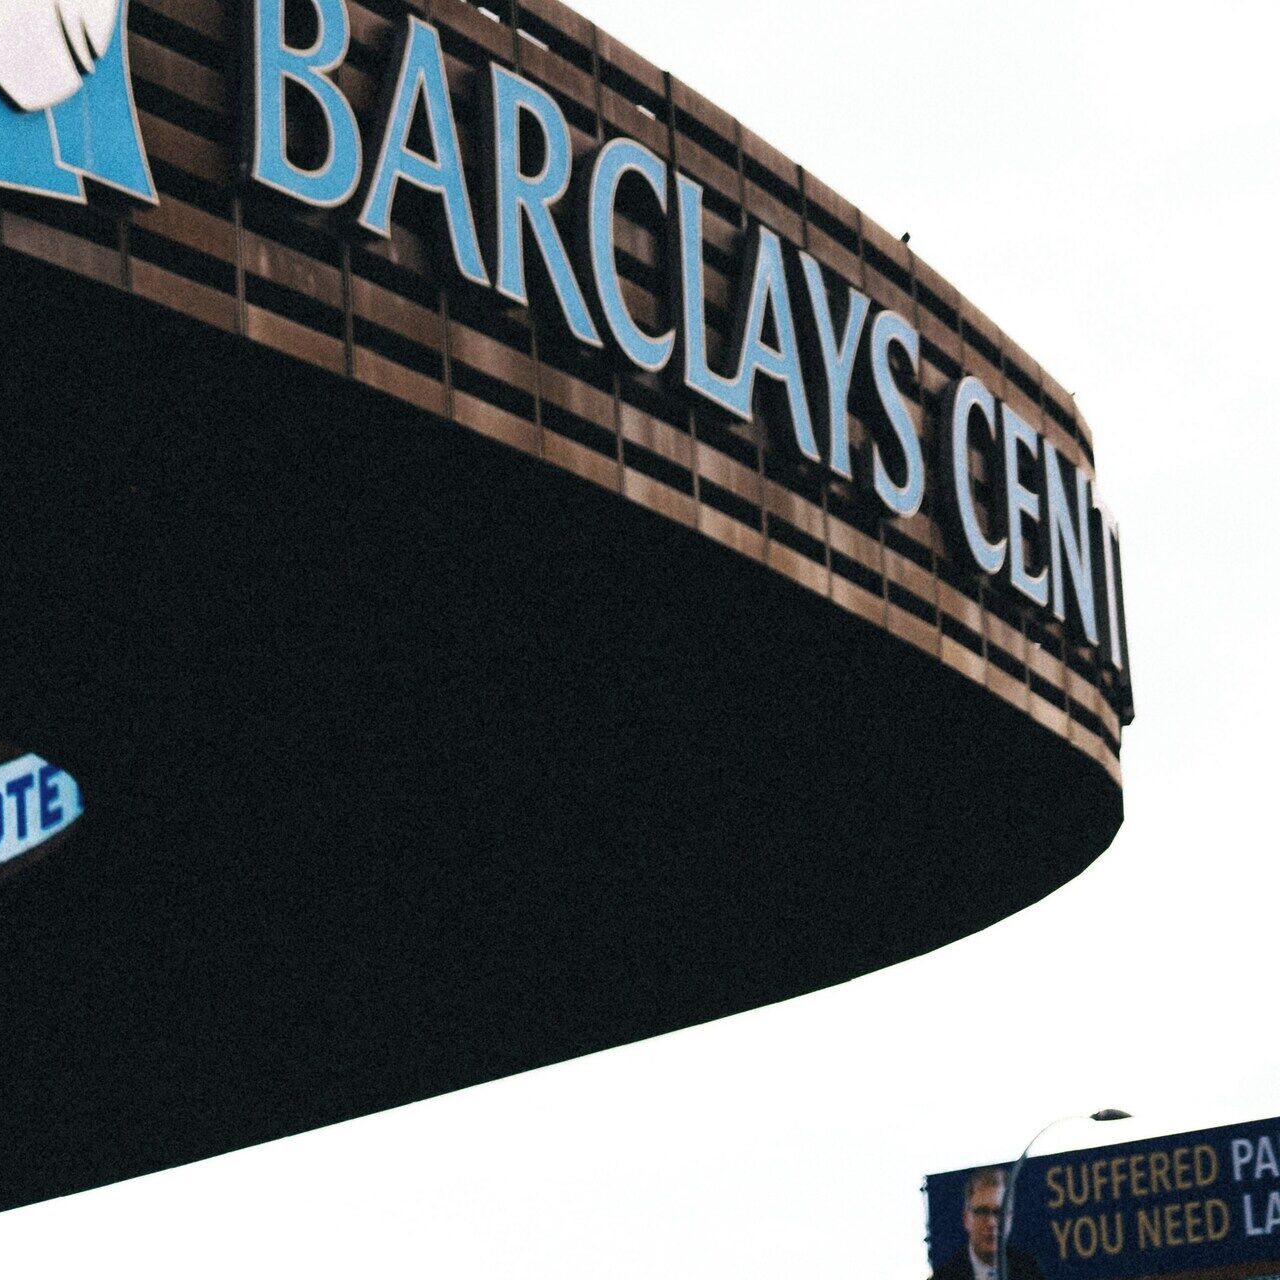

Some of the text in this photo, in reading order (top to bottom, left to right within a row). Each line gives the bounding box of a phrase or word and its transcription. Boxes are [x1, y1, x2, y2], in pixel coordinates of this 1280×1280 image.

[251, 0, 926, 518] BARCLAYS
[1046, 1144, 1219, 1209] SUFFERED
[1050, 1212, 1124, 1261] YOU
[1138, 1199, 1231, 1250] NEED
